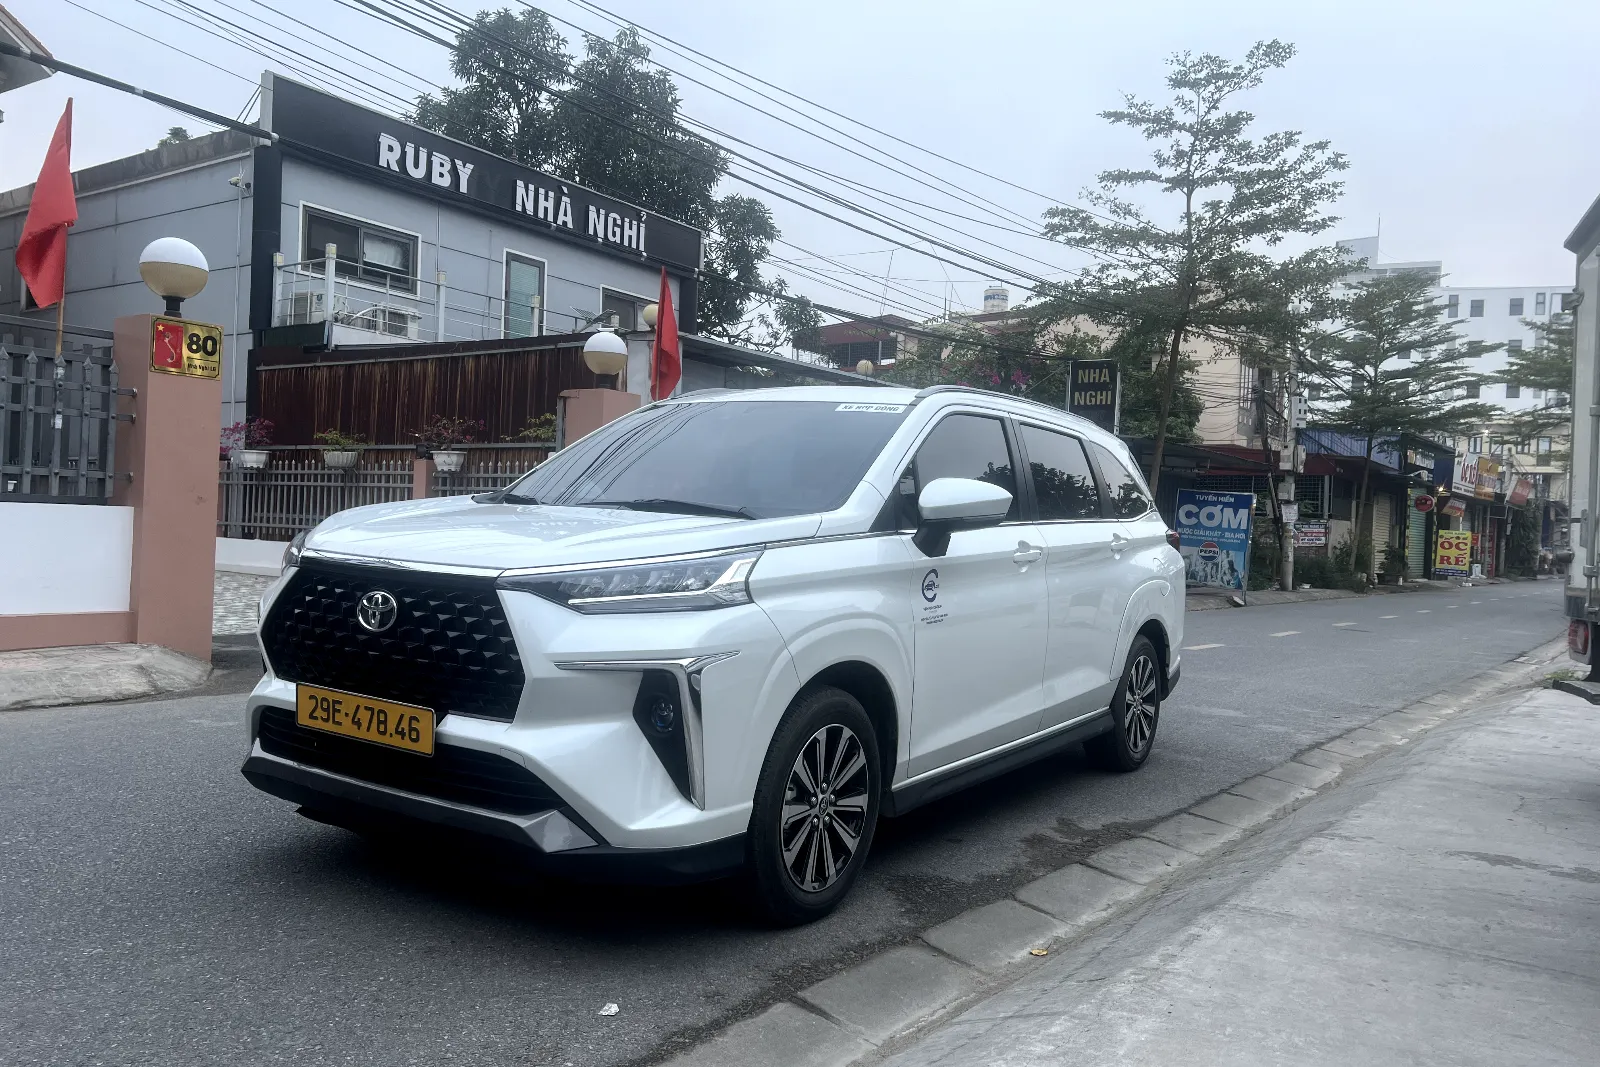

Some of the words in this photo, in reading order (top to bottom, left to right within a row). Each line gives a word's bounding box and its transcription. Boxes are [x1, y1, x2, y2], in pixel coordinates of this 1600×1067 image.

[379, 132, 475, 194] RUBY
[515, 179, 574, 229] NHÀ
[587, 204, 647, 252] NGHỈ
[187, 332, 218, 357] 80
[1078, 363, 1110, 384] NHÀ
[1074, 385, 1113, 406] NGHỈ
[1179, 504, 1249, 530] CƠM
[1200, 548, 1219, 556] PEPSI
[308, 694, 420, 744] 29E-478.46
